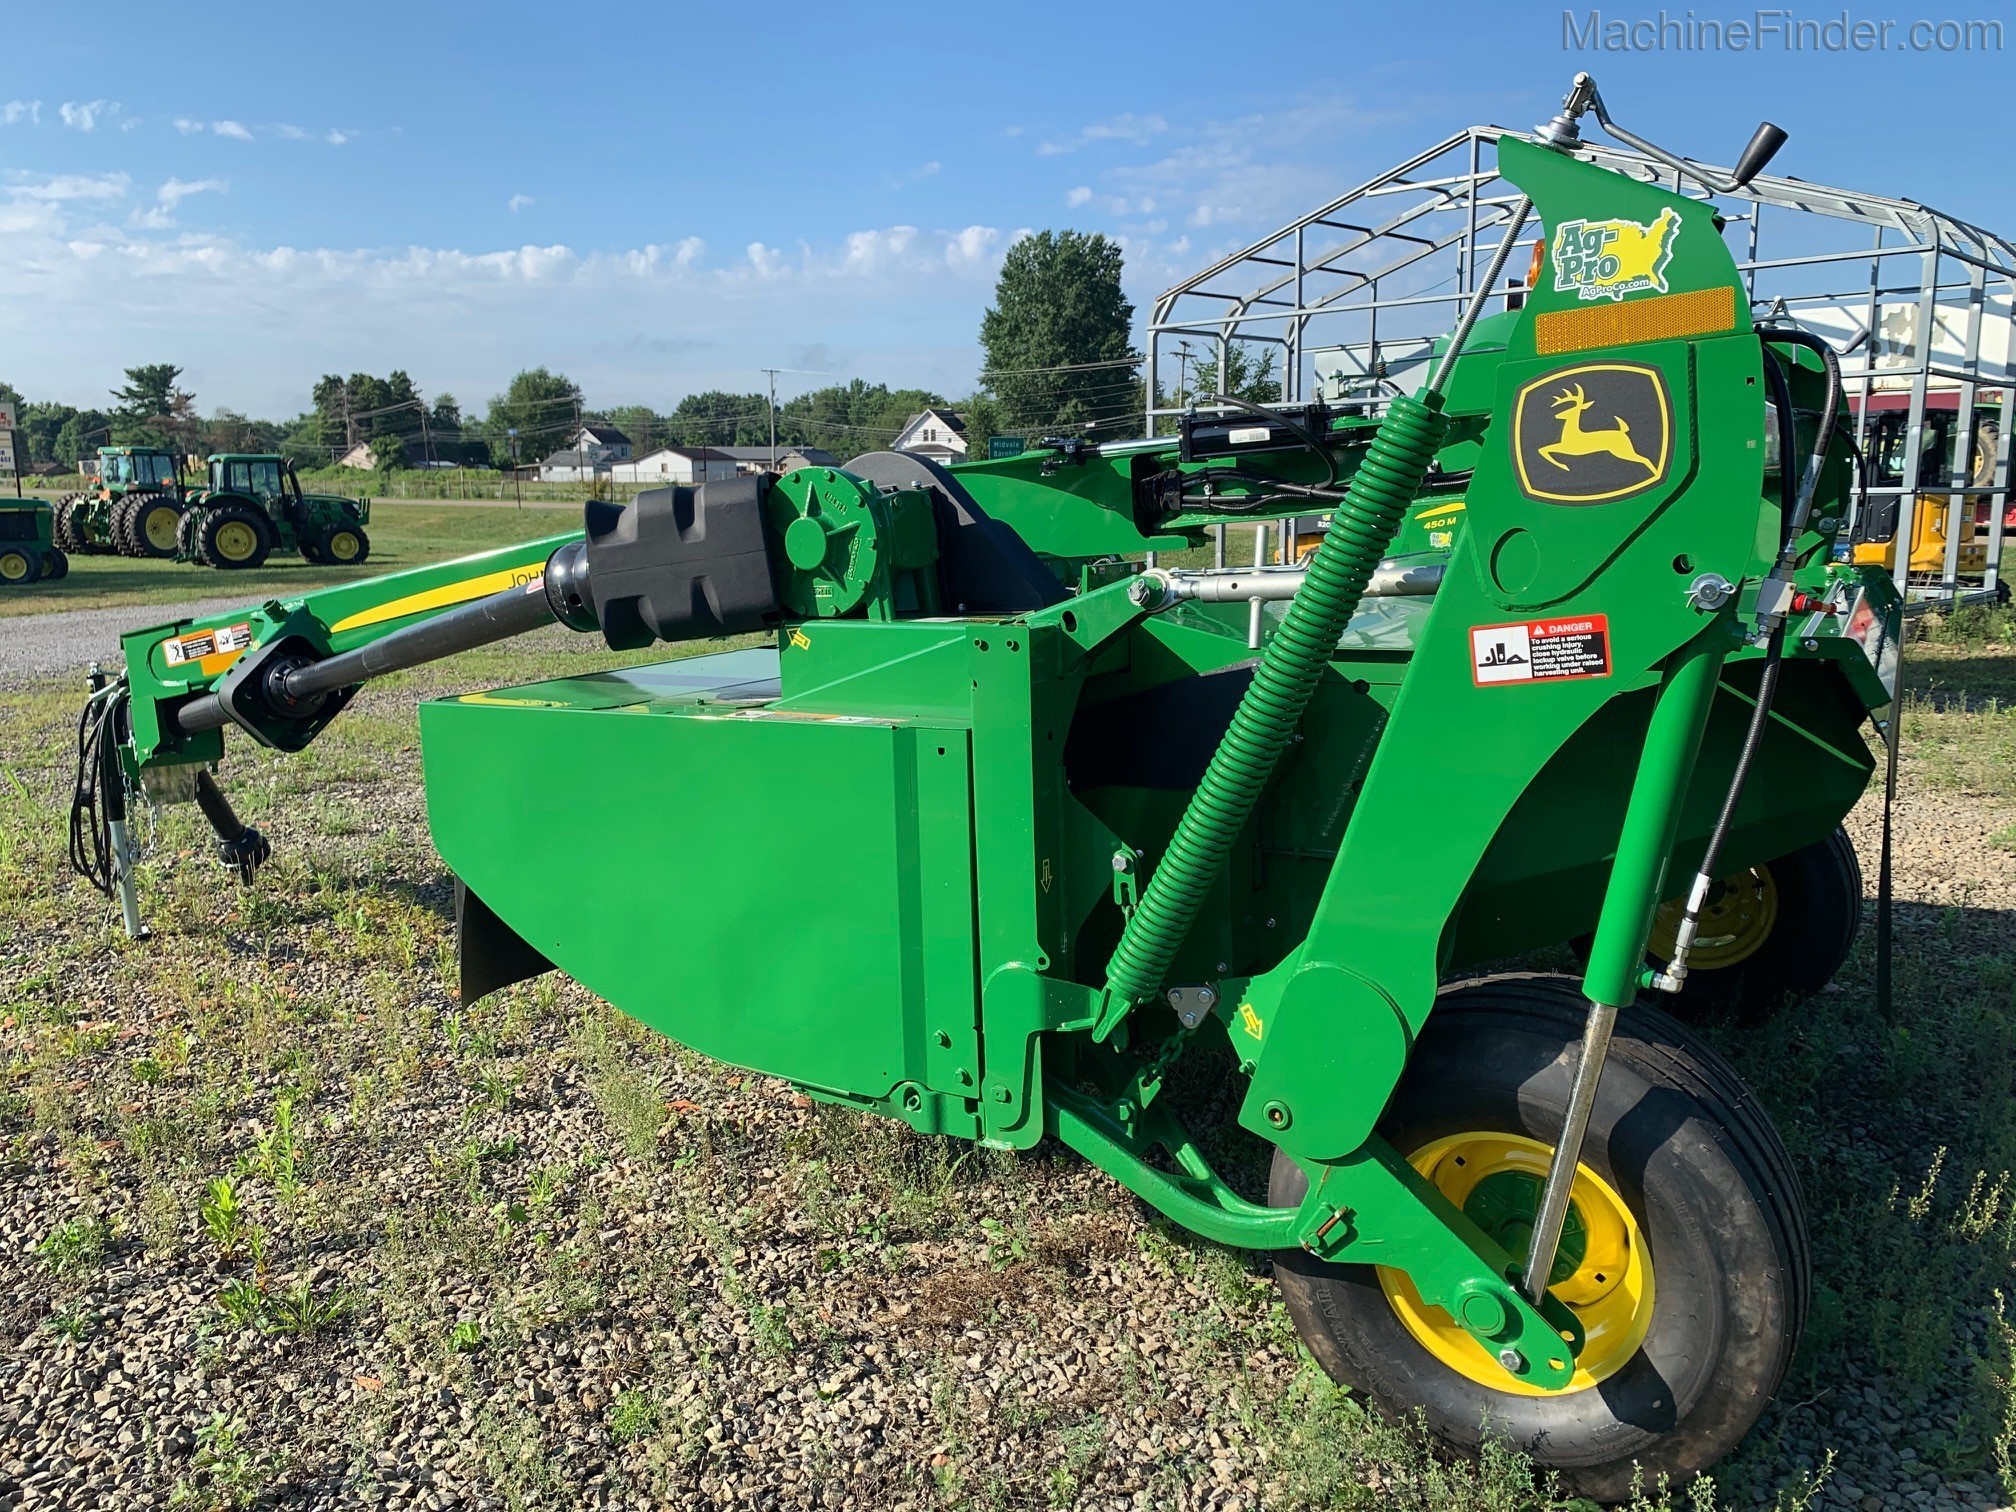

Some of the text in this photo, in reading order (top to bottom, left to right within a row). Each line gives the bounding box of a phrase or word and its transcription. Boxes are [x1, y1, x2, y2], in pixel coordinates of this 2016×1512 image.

[1558, 222, 1619, 258] Ag-
[1558, 255, 1620, 288] Pro
[1582, 279, 1650, 297] AgProCo.com
[1423, 517, 1456, 529] 450 M
[1549, 622, 1593, 633] DANGER
[1532, 644, 1561, 652] crushing
[1532, 648, 1582, 658] close hydraulic
[1533, 656, 1556, 665] lockup
[1557, 654, 1574, 662] valve
[1534, 663, 1560, 671] working
[1582, 659, 1604, 667] raised
[1534, 668, 1569, 677] harvesting
